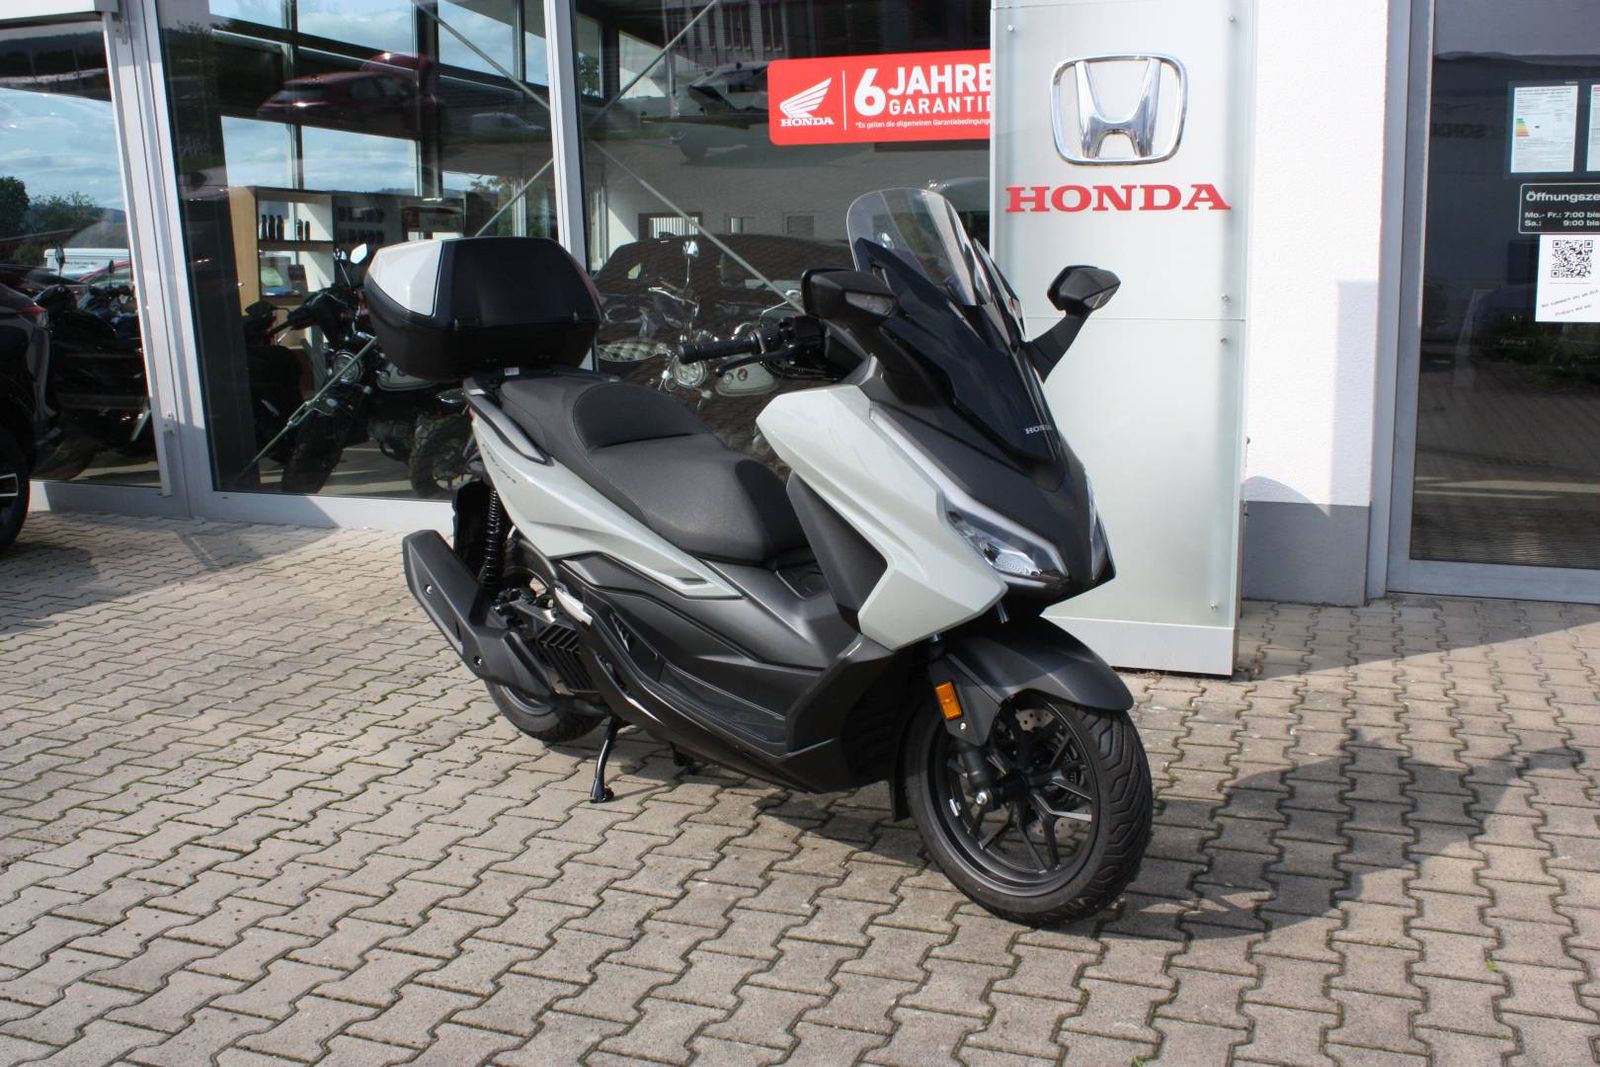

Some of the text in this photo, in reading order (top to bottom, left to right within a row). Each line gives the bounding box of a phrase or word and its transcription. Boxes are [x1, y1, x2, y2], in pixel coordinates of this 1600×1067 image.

[887, 63, 991, 96] JAHRE
[854, 68, 886, 116] 6
[780, 117, 835, 127] HONDA
[867, 121, 885, 129] gelten
[896, 119, 932, 128] allgemeinen
[1005, 184, 1232, 213] HONDA
[1524, 219, 1600, 227] Sa.: 9:00 bis
